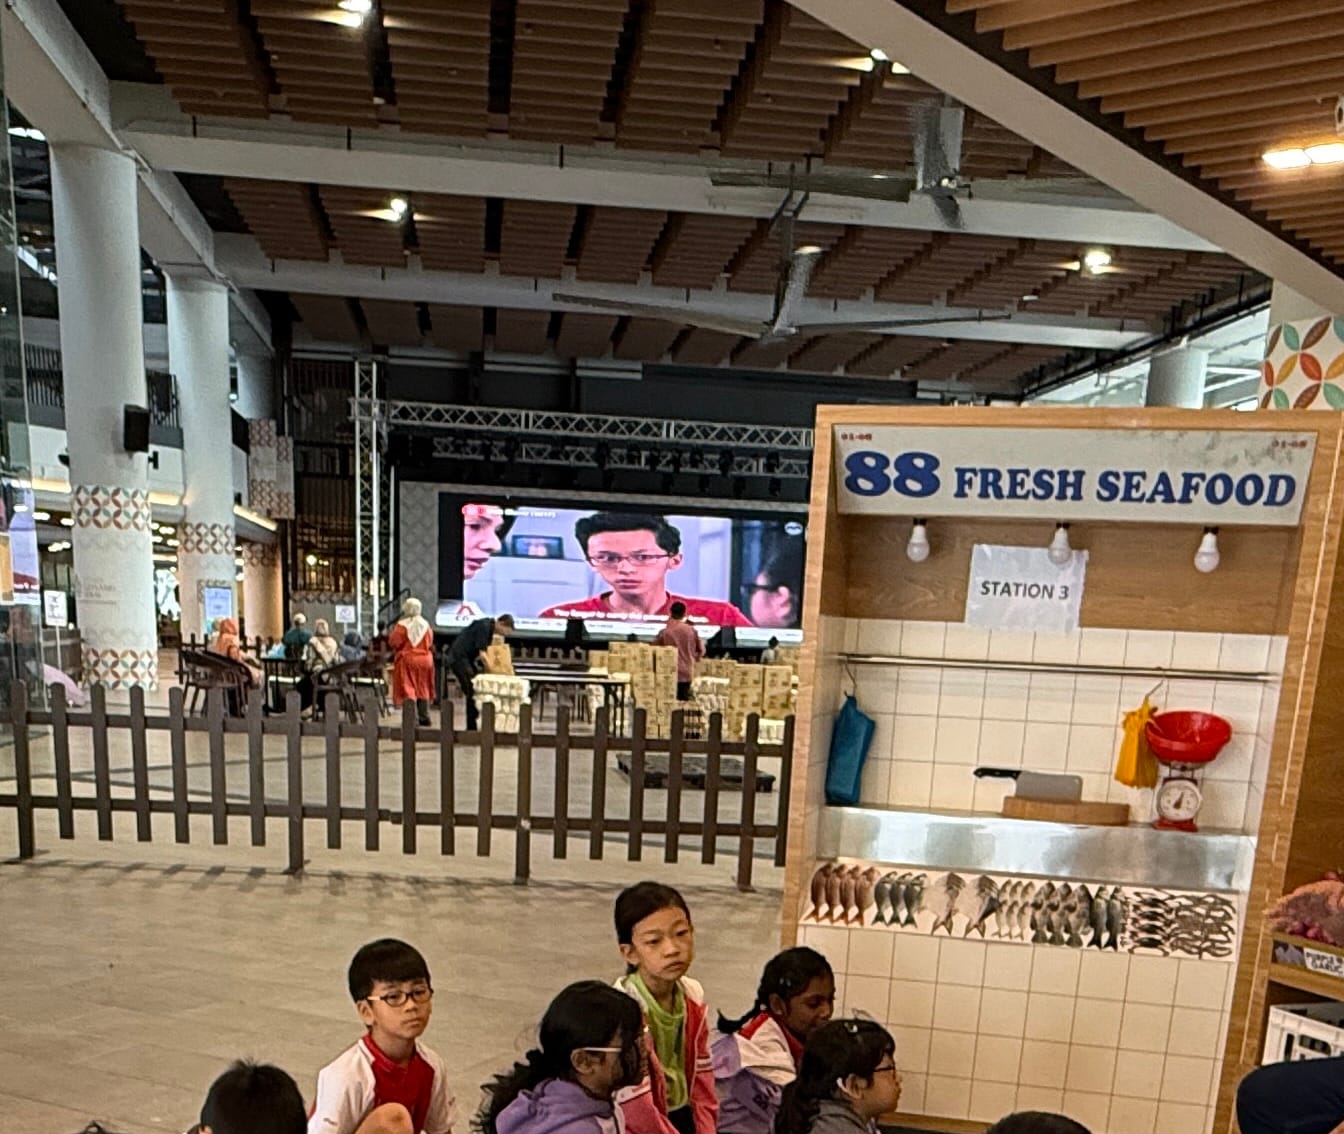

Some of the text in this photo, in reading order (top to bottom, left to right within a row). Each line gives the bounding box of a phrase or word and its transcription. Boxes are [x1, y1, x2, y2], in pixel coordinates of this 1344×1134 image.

[844, 450, 1297, 507] 88 FRESH SEAFOOD
[980, 580, 1070, 600] STATION 3
